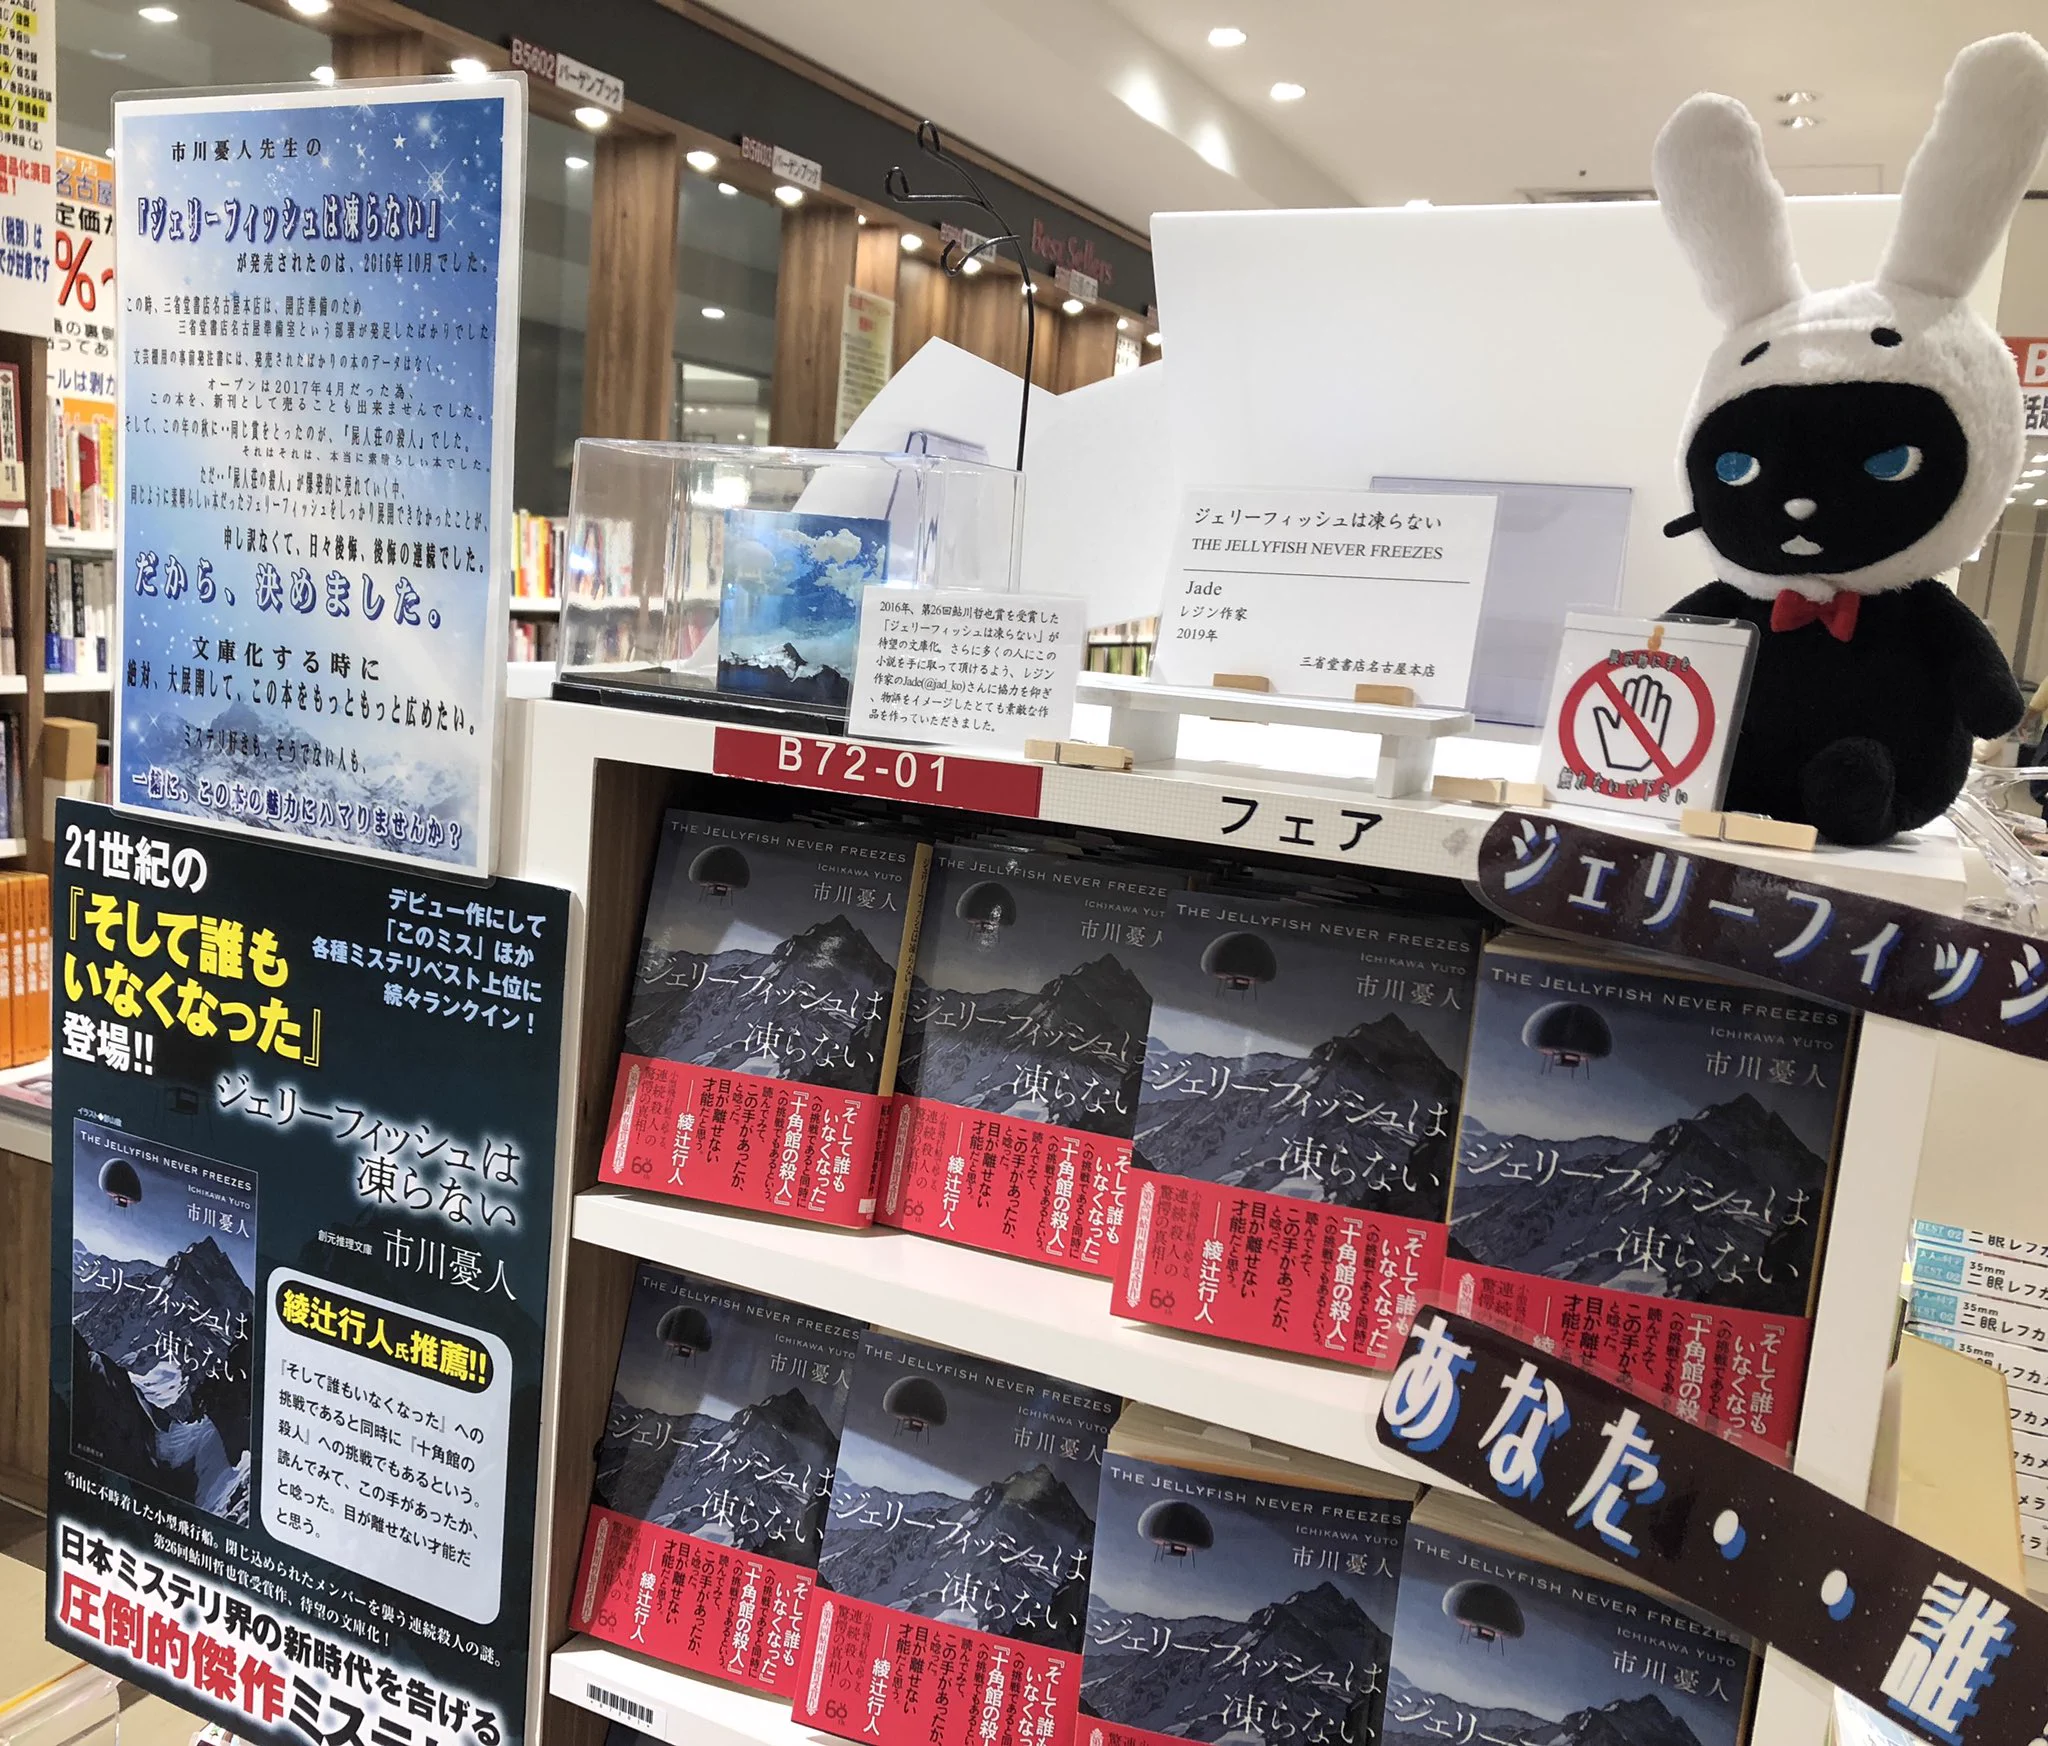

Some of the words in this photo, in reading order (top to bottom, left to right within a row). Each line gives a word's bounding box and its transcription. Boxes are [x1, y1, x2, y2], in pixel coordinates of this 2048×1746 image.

[171, 137, 321, 162] 市川憂人先生の
[137, 192, 440, 243] 『ジェリーフィッシュは凍らない』
[237, 252, 489, 274] が発売されたのは、2016年10月でした。
[150, 391, 485, 421] この本を、新刊として売ることも出来ませんでした。
[208, 378, 416, 400] オープンは2017年4月だった為、
[243, 445, 491, 474] それはそれは、本当に素晴らしい本でした。
[1194, 507, 1442, 531] ジェリーフィッシュは凍らない
[223, 525, 485, 574] 申し訳なくて、日々後悔、後悔の連続でした。
[1192, 537, 1222, 552] THE
[1225, 539, 1307, 556] JELLYFISH
[1310, 542, 1368, 558] NEVER
[1370, 544, 1443, 560] FREEZES
[134, 551, 441, 629] だから、決めました。
[880, 601, 1059, 624] 2016年、第26回鮎川哲也賞を受賞した
[1179, 605, 1248, 621] レジン作家
[1185, 580, 1222, 596] Jade
[878, 637, 1057, 662] 待望の文庫化。さらに多くの人にこの
[884, 618, 1060, 643] 「ジェリーフィッシュは凍らない」が
[1176, 628, 1218, 642] 2019年
[192, 635, 380, 682] 文庫化する時に
[876, 656, 1056, 680] 小説を手に取って頂けるよう、レジン
[1299, 655, 1436, 678] 三省堂書店名古屋本店
[127, 658, 476, 736] 絶対、大展開して、この本をもっともっと広めたい。
[868, 709, 996, 733] 品を作っていただきました。
[870, 692, 1049, 719] 、物語をイメージしたとても素敵な作
[183, 725, 367, 775] ミステリ好きも、そうでない人も、
[777, 735, 950, 795] B72-01
[671, 821, 698, 834] THE
[703, 826, 780, 846] JELLYFISH
[786, 837, 834, 853] NEVER
[840, 845, 906, 863] FREEZES
[1220, 796, 1384, 852] フェア
[63, 824, 209, 895] 21世紀の
[817, 862, 870, 878] ICHIKAWA
[874, 870, 903, 882] YUTO
[388, 887, 547, 940] デビュー作にして
[813, 881, 897, 912] 市川憂人
[69, 886, 289, 988] 『そして誰も
[385, 918, 536, 968] 「このミス」ほか
[1176, 904, 1210, 919] THE
[1216, 909, 1313, 933] JELLYFISH
[1319, 923, 1379, 942] NEVER
[1387, 932, 1471, 954] FREEZES
[311, 934, 544, 1004] 各種ミステリベスト上位に
[643, 956, 882, 1021] ジェリーフィッシュは
[1360, 952, 1425, 969] ICHIKAWA
[1431, 962, 1467, 976] YUTO
[63, 953, 322, 1069] いなくなった』
[383, 981, 537, 1036] 続々ランクイン！
[1356, 974, 1463, 1011] 市川憂人
[1491, 967, 1533, 986] THE
[1539, 974, 1652, 1003] JELLYFISH
[1663, 991, 1732, 1014] NEVER
[1742, 1003, 1839, 1026] FREEZES
[744, 1021, 874, 1068] 凍らない
[1710, 1026, 1786, 1046] ICHIKAWA
[1792, 1035, 1833, 1051] YUTO
[1705, 1050, 1828, 1089] 市川憂人
[705, 1079, 732, 1164] 目が離せない
[1151, 1059, 1449, 1139] ジェリーフィッシュは
[216, 1072, 521, 1187] ジェリーフィッシュは
[667, 1111, 696, 1187] 綾辻行人
[730, 1083, 758, 1192] この手があったか、
[773, 1089, 809, 1207] 『十角館の殺人』
[833, 1098, 861, 1193] 『そして誰も
[80, 1130, 101, 1148] THE
[104, 1137, 160, 1165] JELLYFISH
[163, 1156, 199, 1177] NEVER
[202, 1168, 252, 1192] FREEZES
[807, 1108, 840, 1213] いなくなった』
[1279, 1136, 1440, 1193] 凍らない
[1465, 1141, 1811, 1227] ジェリーフィッシュは
[187, 1184, 226, 1205] ICHIKAWA
[228, 1196, 251, 1211] YUTO
[355, 1155, 519, 1228] 凍らない
[186, 1202, 250, 1239] 市川憂人
[317, 1229, 373, 1257] 創元推理文庫
[383, 1228, 517, 1302] 市川憂人
[1615, 1225, 1799, 1285] 凍らない
[1969, 1261, 2006, 1276] 35mm
[77, 1255, 249, 1342] ジェリーフィッシュは
[1963, 1301, 1999, 1316] 35mm
[281, 1288, 488, 1385] 綾辻行人氏推薦!!
[1959, 1343, 1995, 1358] 35mm
[1960, 1313, 2047, 1342] 二眼レフカ
[152, 1329, 248, 1383] 凍らない
[279, 1358, 484, 1446] 『そして誰もいなくなった』への
[278, 1388, 475, 1473] 挑戦であると同時に『十角館の
[277, 1418, 482, 1510] 殺人』への挑戦でもあるという。
[276, 1448, 479, 1540] 読んでみて、この手があったか、
[1110, 1466, 1145, 1485] THE
[1151, 1475, 1247, 1503] JELLYFISH
[1255, 1495, 1313, 1515] NEVER
[1321, 1506, 1402, 1526] FREEZES
[276, 1477, 472, 1569] と唸った。目が離せない才能だ
[276, 1508, 321, 1539] と思う。
[835, 1492, 1088, 1581] ジェリーフィッシュは
[1295, 1525, 1358, 1542] ICHIKAWA
[1364, 1533, 1398, 1546] YUTO
[1292, 1546, 1394, 1579] 市川憂人
[941, 1571, 1078, 1629] 凍らない
[60, 1523, 501, 1746] 日本ミステリ界の新時代を告げる
[1093, 1617, 1383, 1695] ジェリーフィッシュは
[1222, 1693, 1376, 1744] 凍らない
